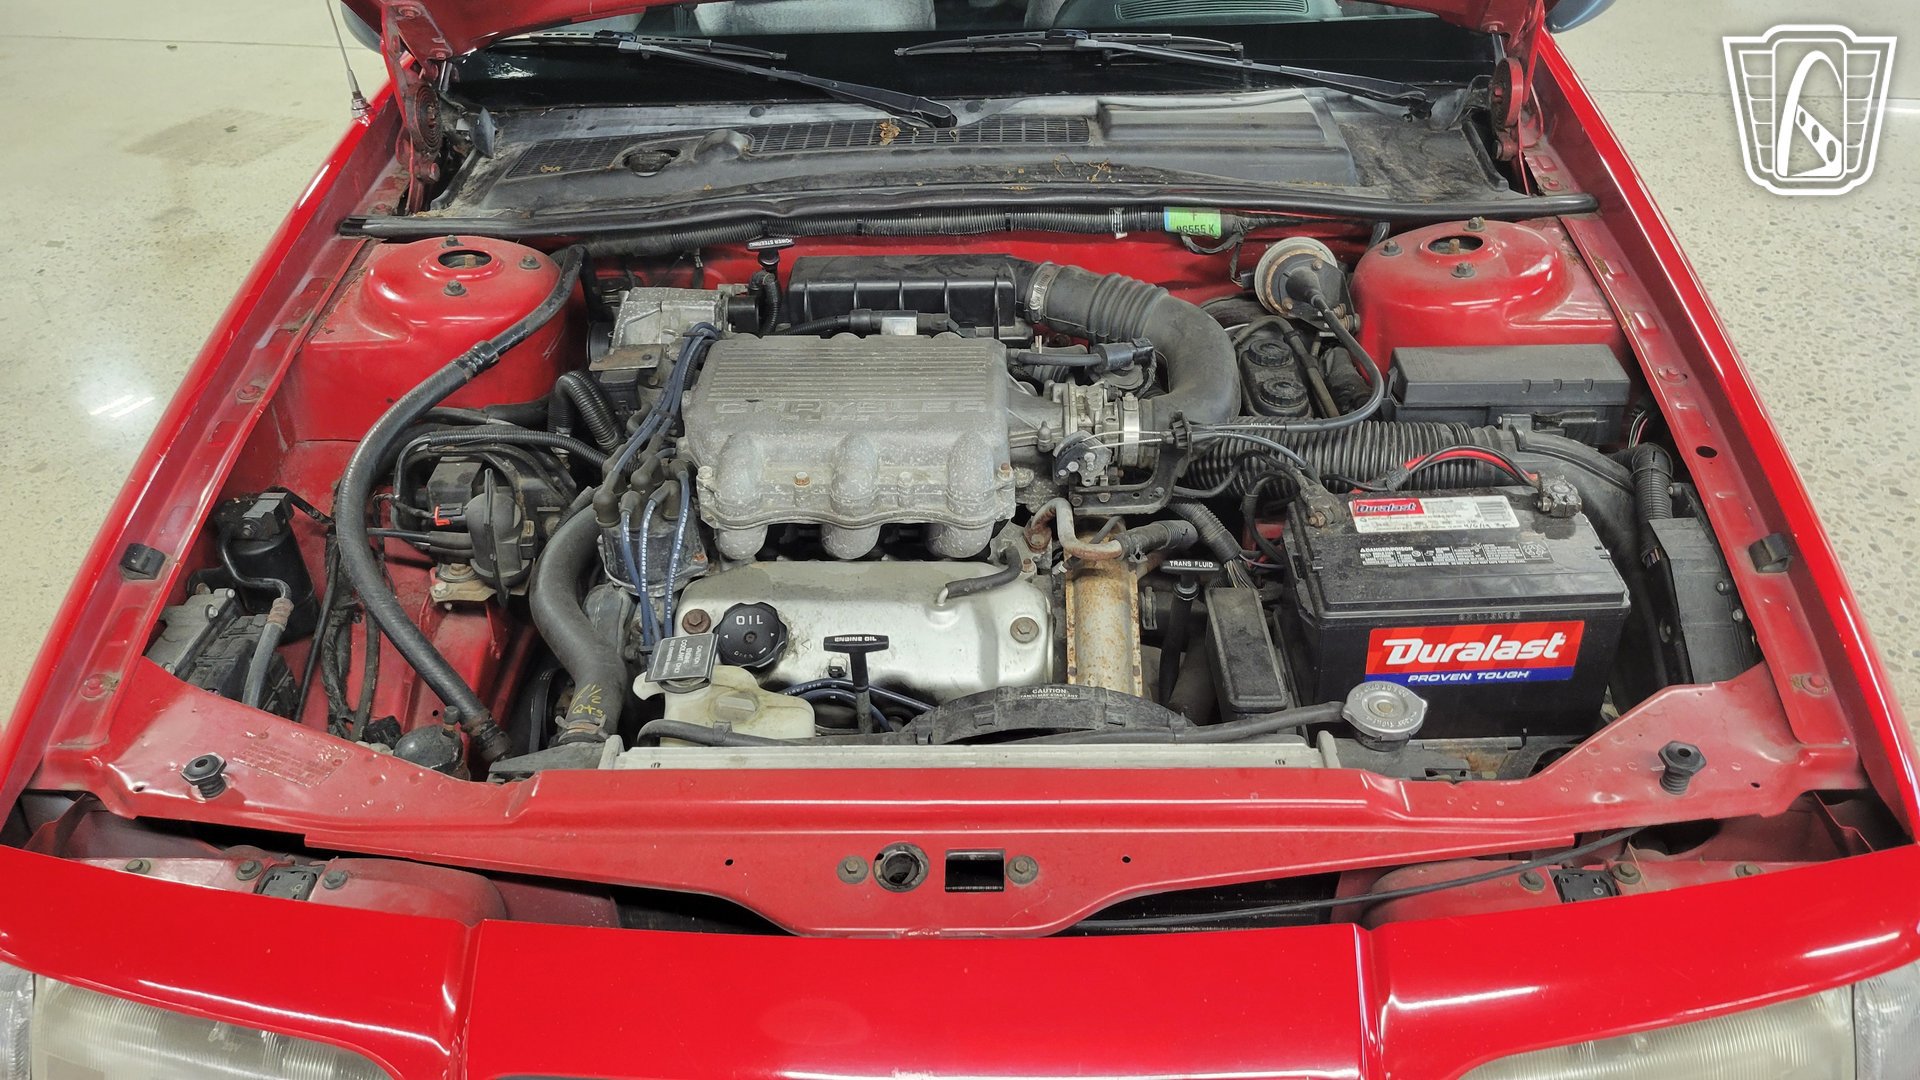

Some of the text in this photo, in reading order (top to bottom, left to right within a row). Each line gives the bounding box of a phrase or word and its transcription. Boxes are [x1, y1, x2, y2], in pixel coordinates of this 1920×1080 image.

[1357, 502, 1417, 513] Duralast
[735, 614, 764, 626] OIL
[1382, 631, 1567, 666] Duralast
[1407, 670, 1530, 683] PROVEN TOUGH
